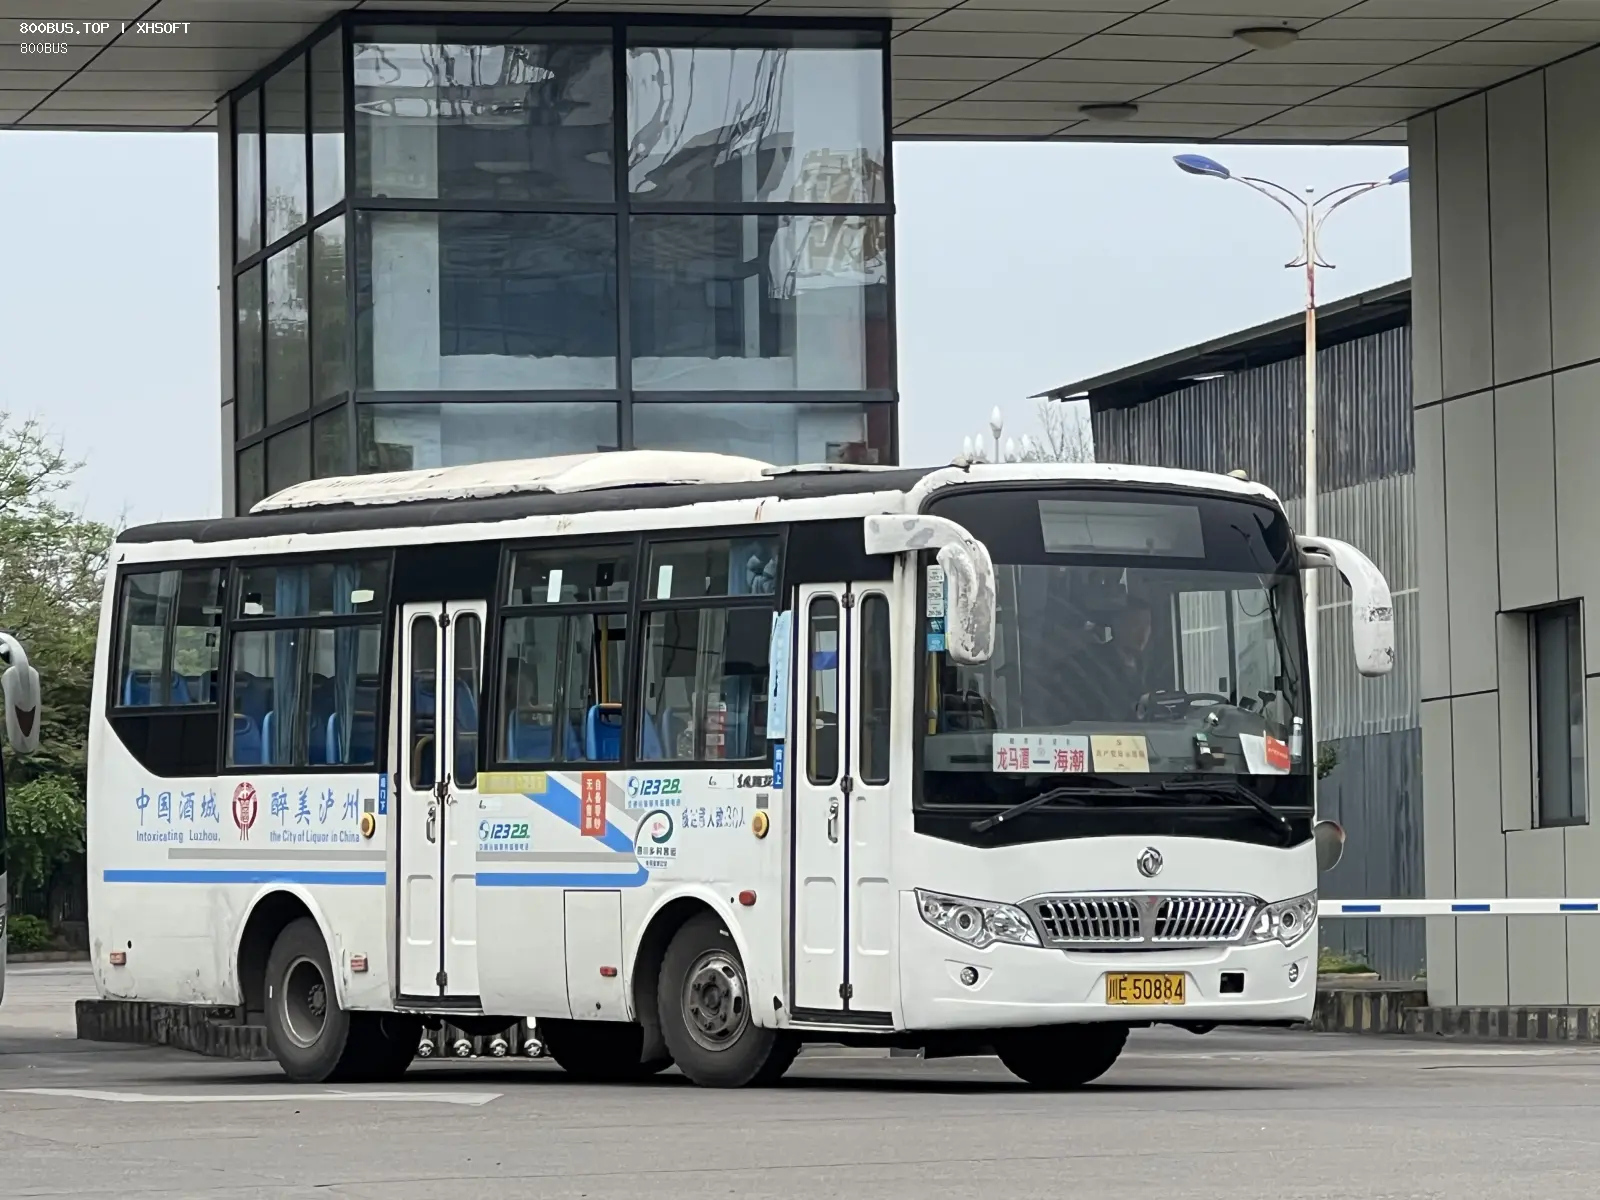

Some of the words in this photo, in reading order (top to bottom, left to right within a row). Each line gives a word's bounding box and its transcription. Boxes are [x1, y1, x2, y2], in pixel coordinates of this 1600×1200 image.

[639, 778, 681, 795] 12328
[135, 787, 220, 827] 中国酒城
[271, 786, 360, 826] 醉美泸州
[136, 829, 184, 843] Intoxicating
[270, 830, 281, 842] the
[282, 829, 296, 844] City
[297, 830, 305, 842] of
[306, 830, 329, 844] Liquor
[331, 830, 338, 843] in
[340, 830, 360, 843] China
[490, 823, 530, 839] 12328
